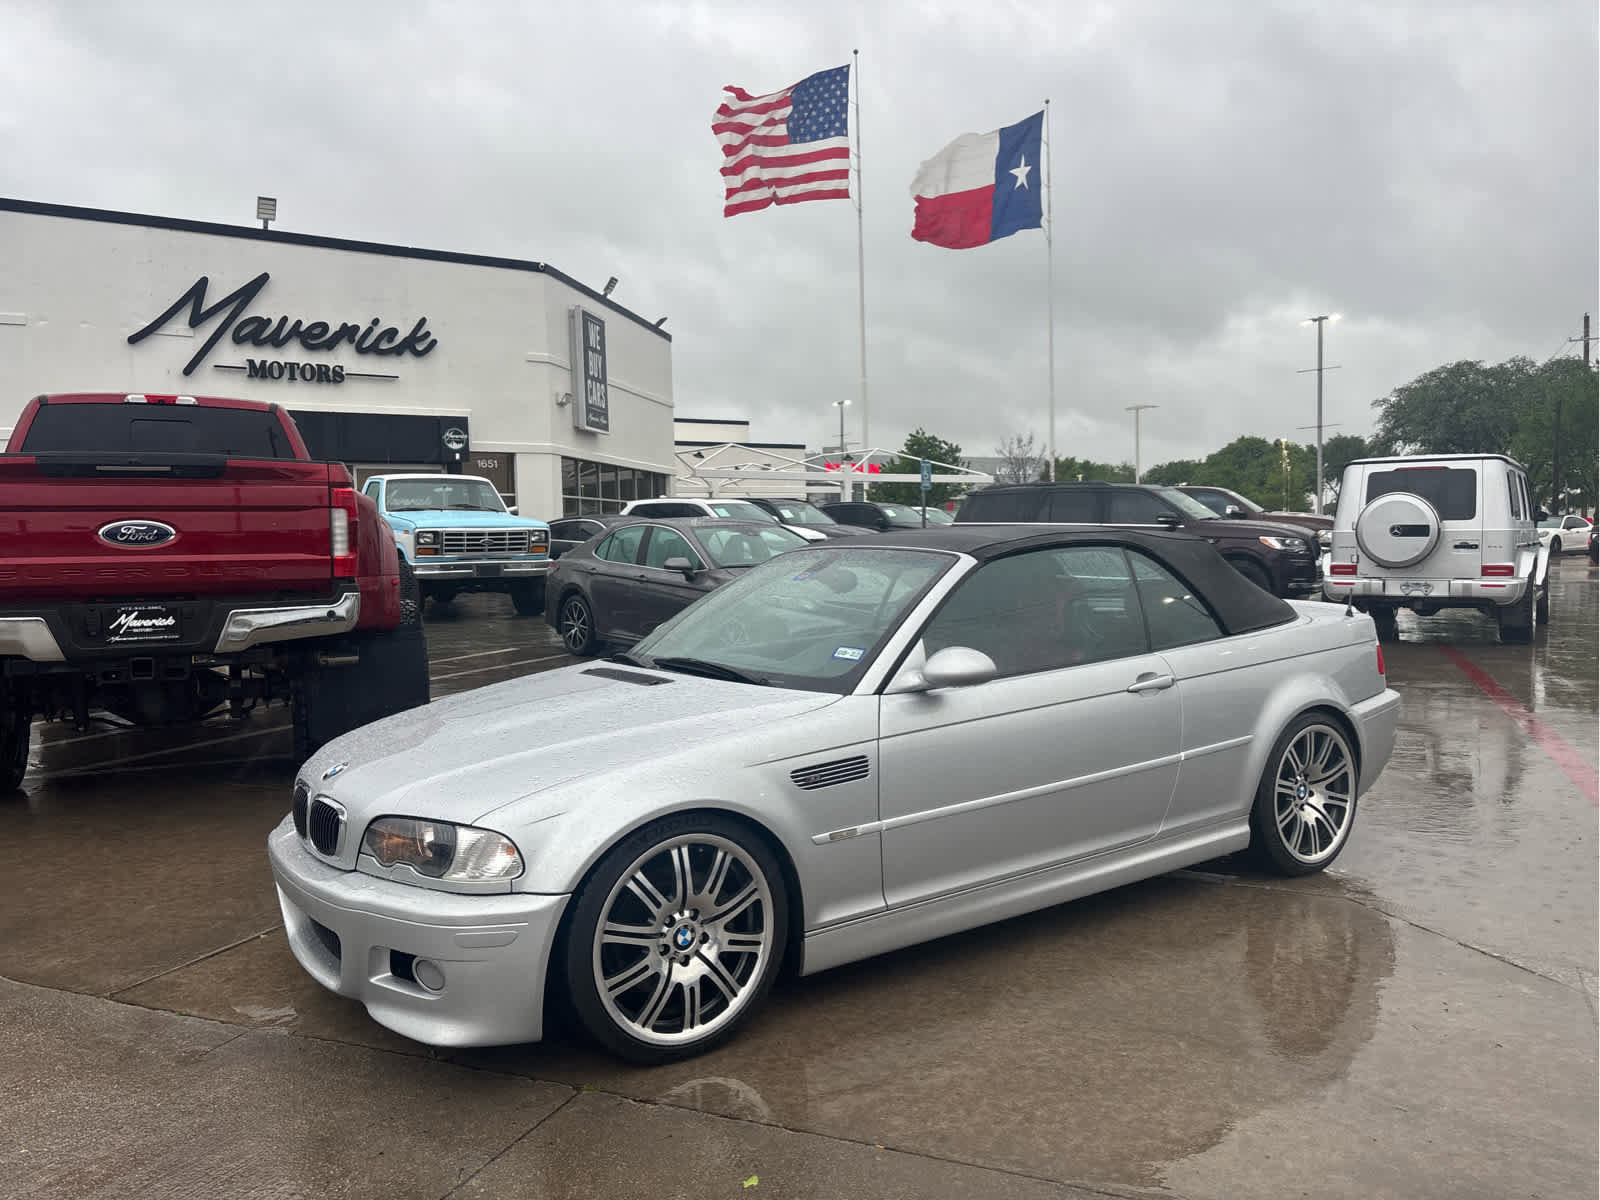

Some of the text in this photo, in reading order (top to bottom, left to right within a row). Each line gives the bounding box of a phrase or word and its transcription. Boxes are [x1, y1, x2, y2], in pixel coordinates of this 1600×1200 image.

[127, 272, 438, 376] Maverick
[587, 319, 601, 350] WE
[246, 359, 345, 383] MOTORS
[588, 350, 602, 379] BUY
[587, 379, 606, 408] CARS
[477, 459, 498, 468] 1651
[117, 525, 157, 541] Ford
[109, 611, 175, 634] Maverick
